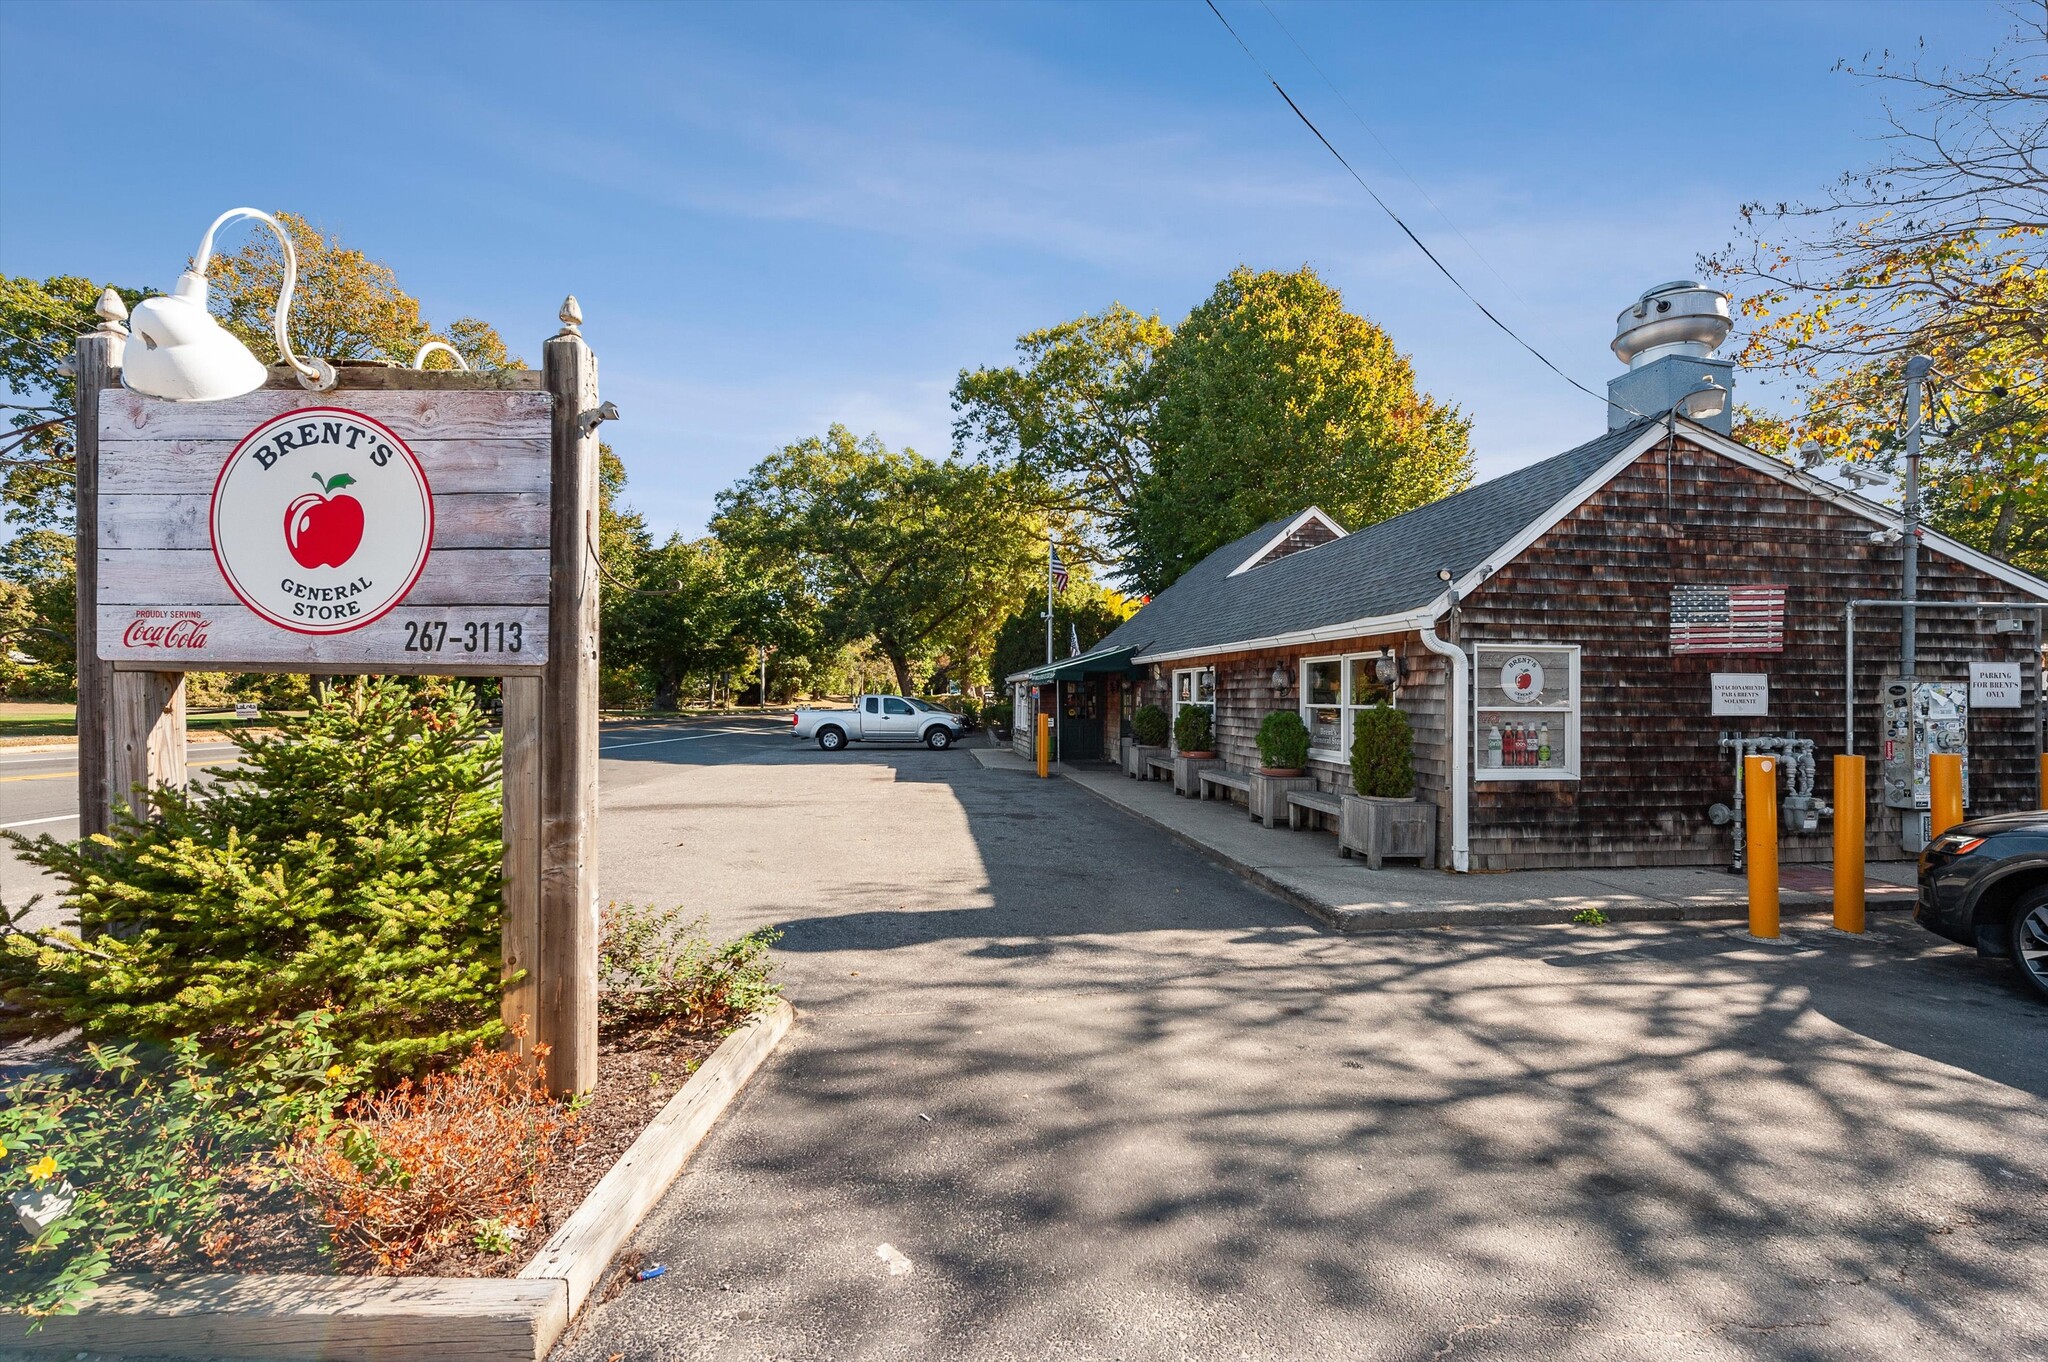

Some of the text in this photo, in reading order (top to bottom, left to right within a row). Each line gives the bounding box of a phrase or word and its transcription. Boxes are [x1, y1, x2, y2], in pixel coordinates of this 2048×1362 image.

[252, 422, 394, 471] BRENT'S
[281, 577, 373, 601] GENERAL
[136, 610, 202, 618] PROUDLY SERVING
[293, 601, 361, 620] STORE
[123, 619, 212, 648] Coca-Cola
[405, 621, 523, 652] 267-3113
[1508, 658, 1537, 668] BRENT'S
